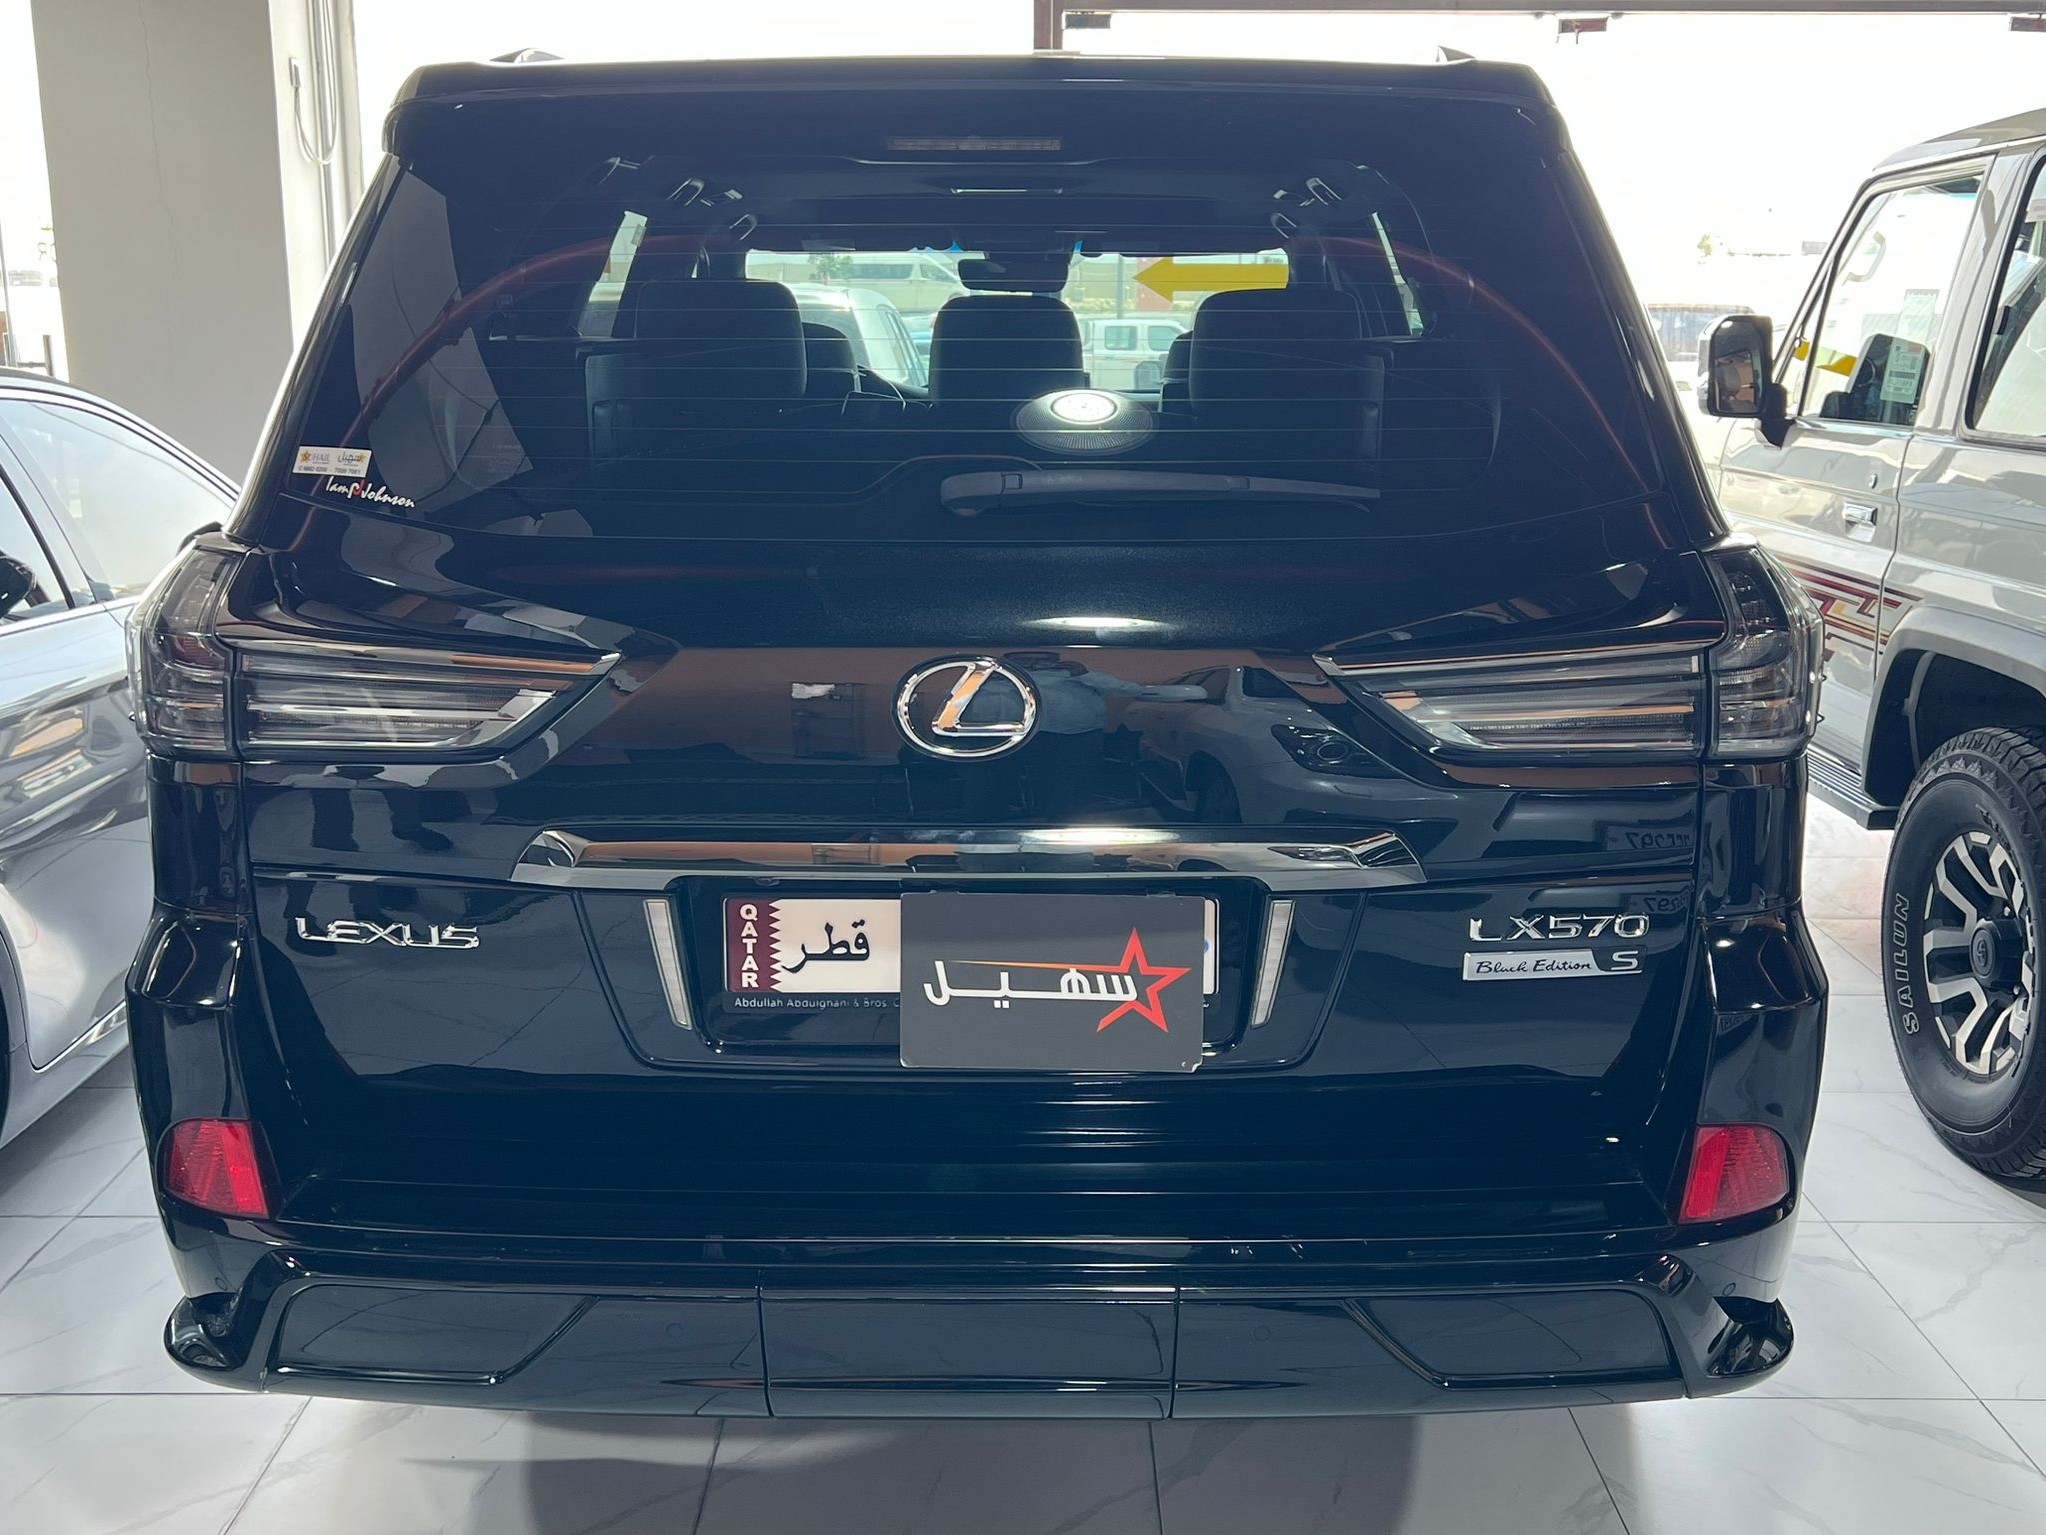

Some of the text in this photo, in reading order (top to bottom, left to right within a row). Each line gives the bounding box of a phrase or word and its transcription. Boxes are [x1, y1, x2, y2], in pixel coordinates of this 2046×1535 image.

[295, 917, 480, 949] LEXUS
[739, 904, 760, 988] QATAR
[781, 918, 870, 974] قطر
[1469, 912, 1650, 942] LX570
[1532, 958, 1592, 973] Edition
[1610, 950, 1640, 971] S
[1892, 892, 1920, 1034] SAILUN
[734, 997, 783, 1008] Abdullah
[923, 960, 1138, 1009] سهيل
